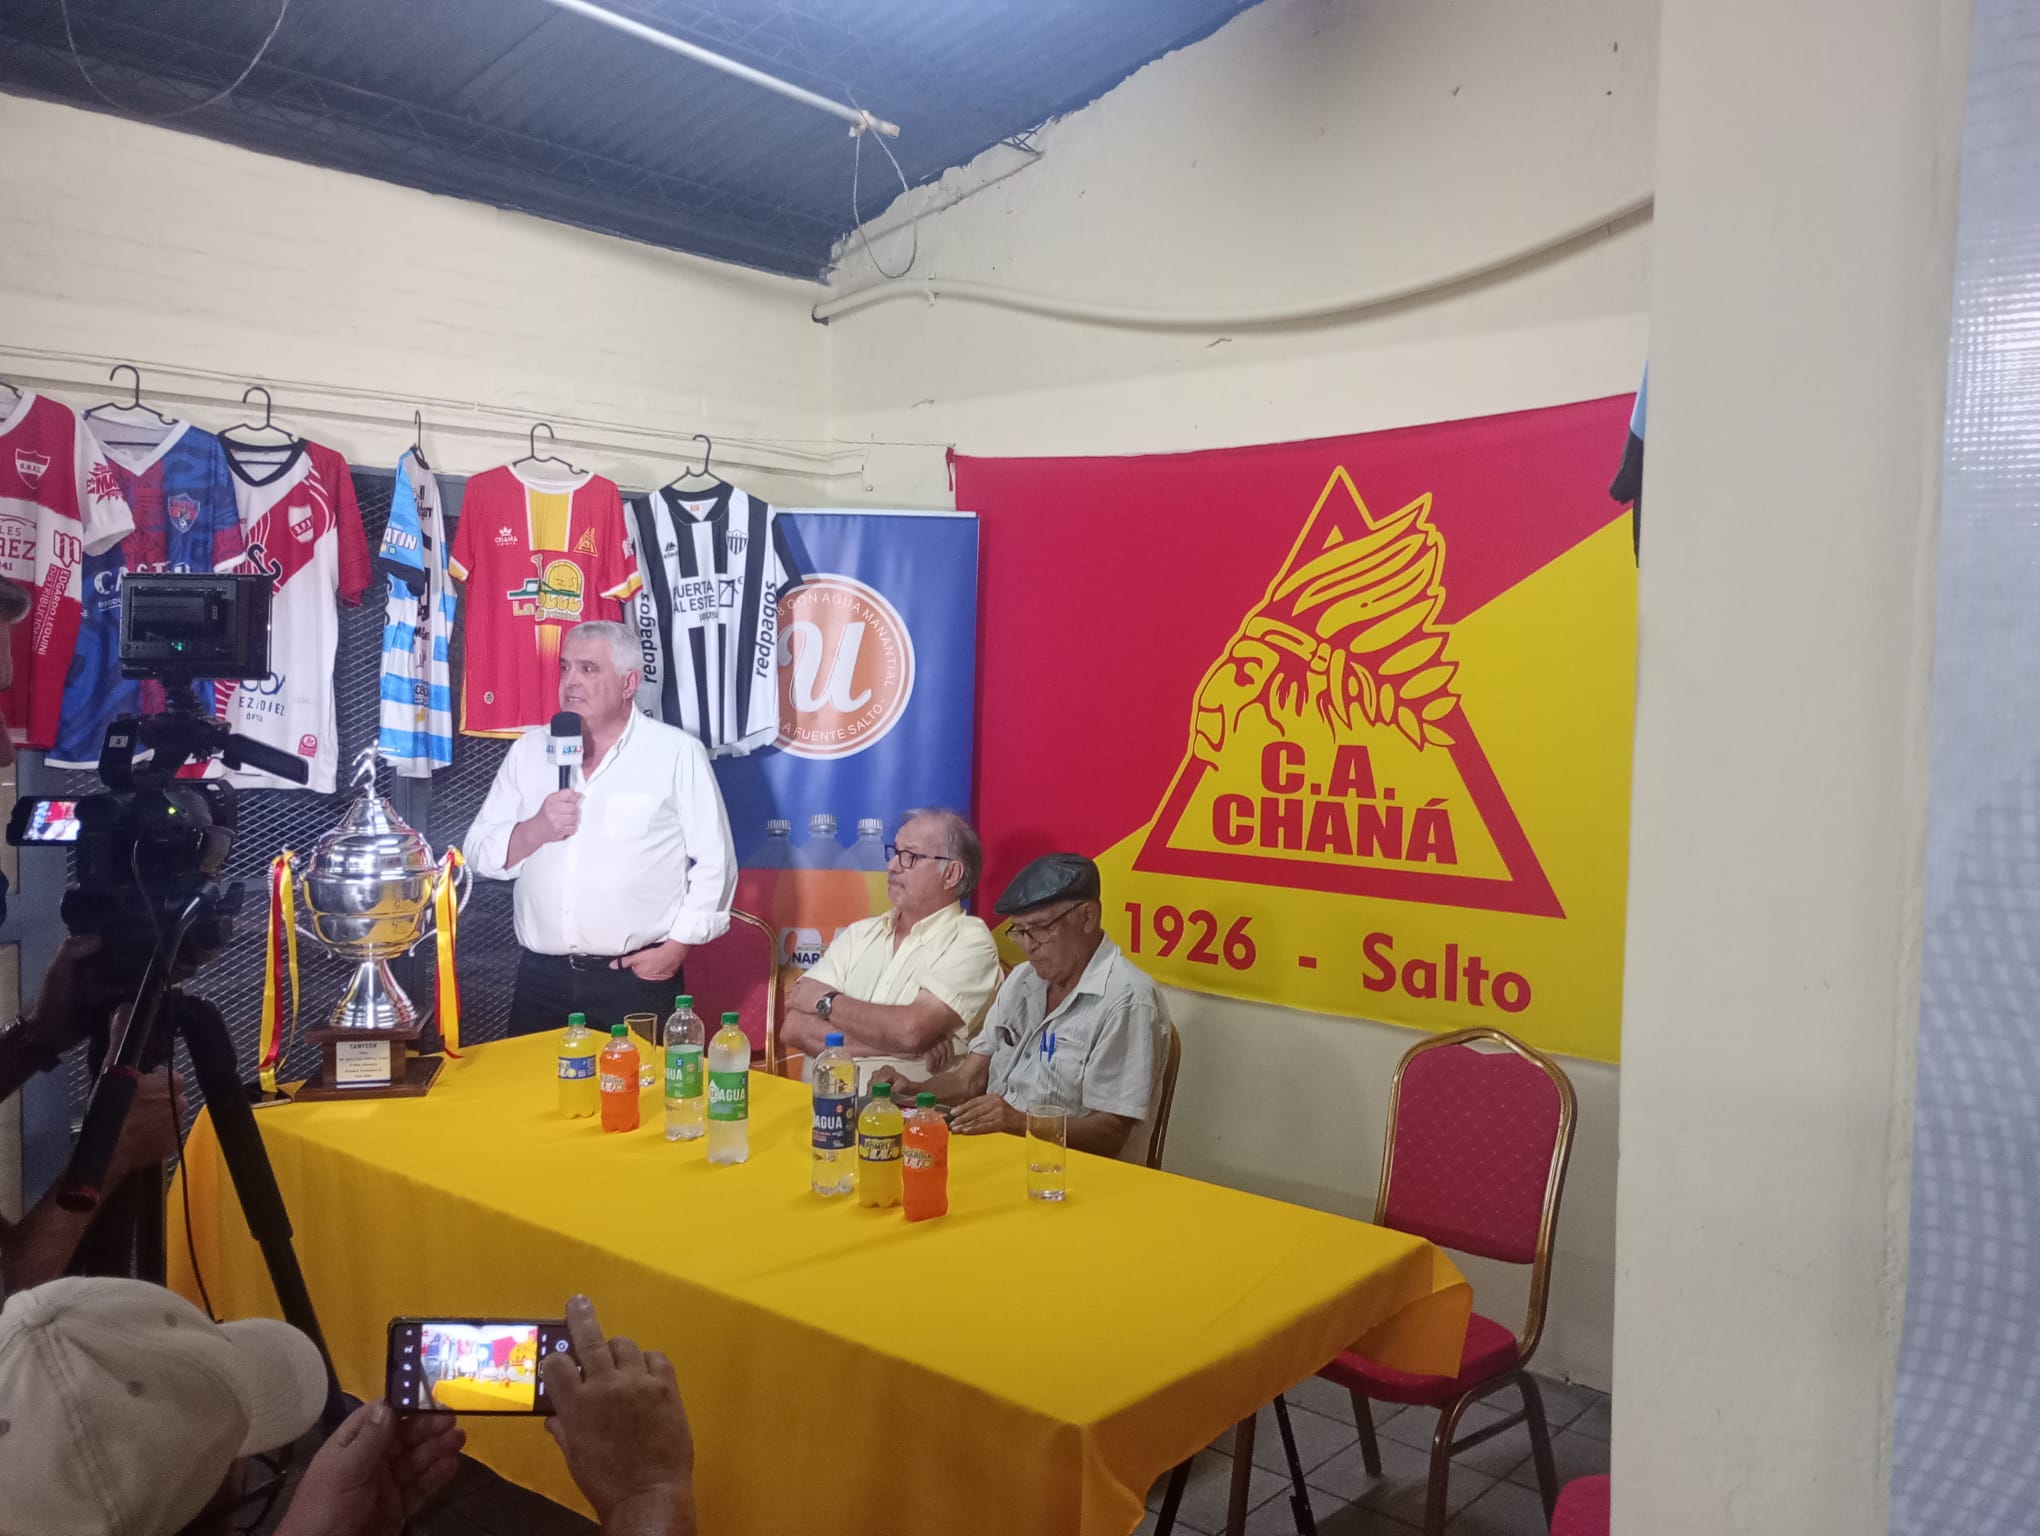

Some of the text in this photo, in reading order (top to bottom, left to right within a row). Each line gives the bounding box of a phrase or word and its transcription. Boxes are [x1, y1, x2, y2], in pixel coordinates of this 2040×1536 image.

[49, 570, 70, 618] EDGARDO
[673, 594, 716, 614] AL ESTE
[639, 592, 658, 684] redpagos
[754, 581, 778, 679] redpagos
[822, 592, 861, 614] AGUA
[861, 610, 897, 688] MANANTIAL
[793, 727, 846, 743] FUENTE
[847, 703, 884, 736] SALTO
[1260, 740, 1396, 801] C.A.
[1212, 797, 1458, 865] CHANÁ
[792, 952, 822, 965] NAR
[1124, 902, 1257, 970] 1926
[1362, 931, 1532, 1014] Salto
[719, 1088, 746, 1102] AGUA
[814, 1114, 843, 1130] AGUA
